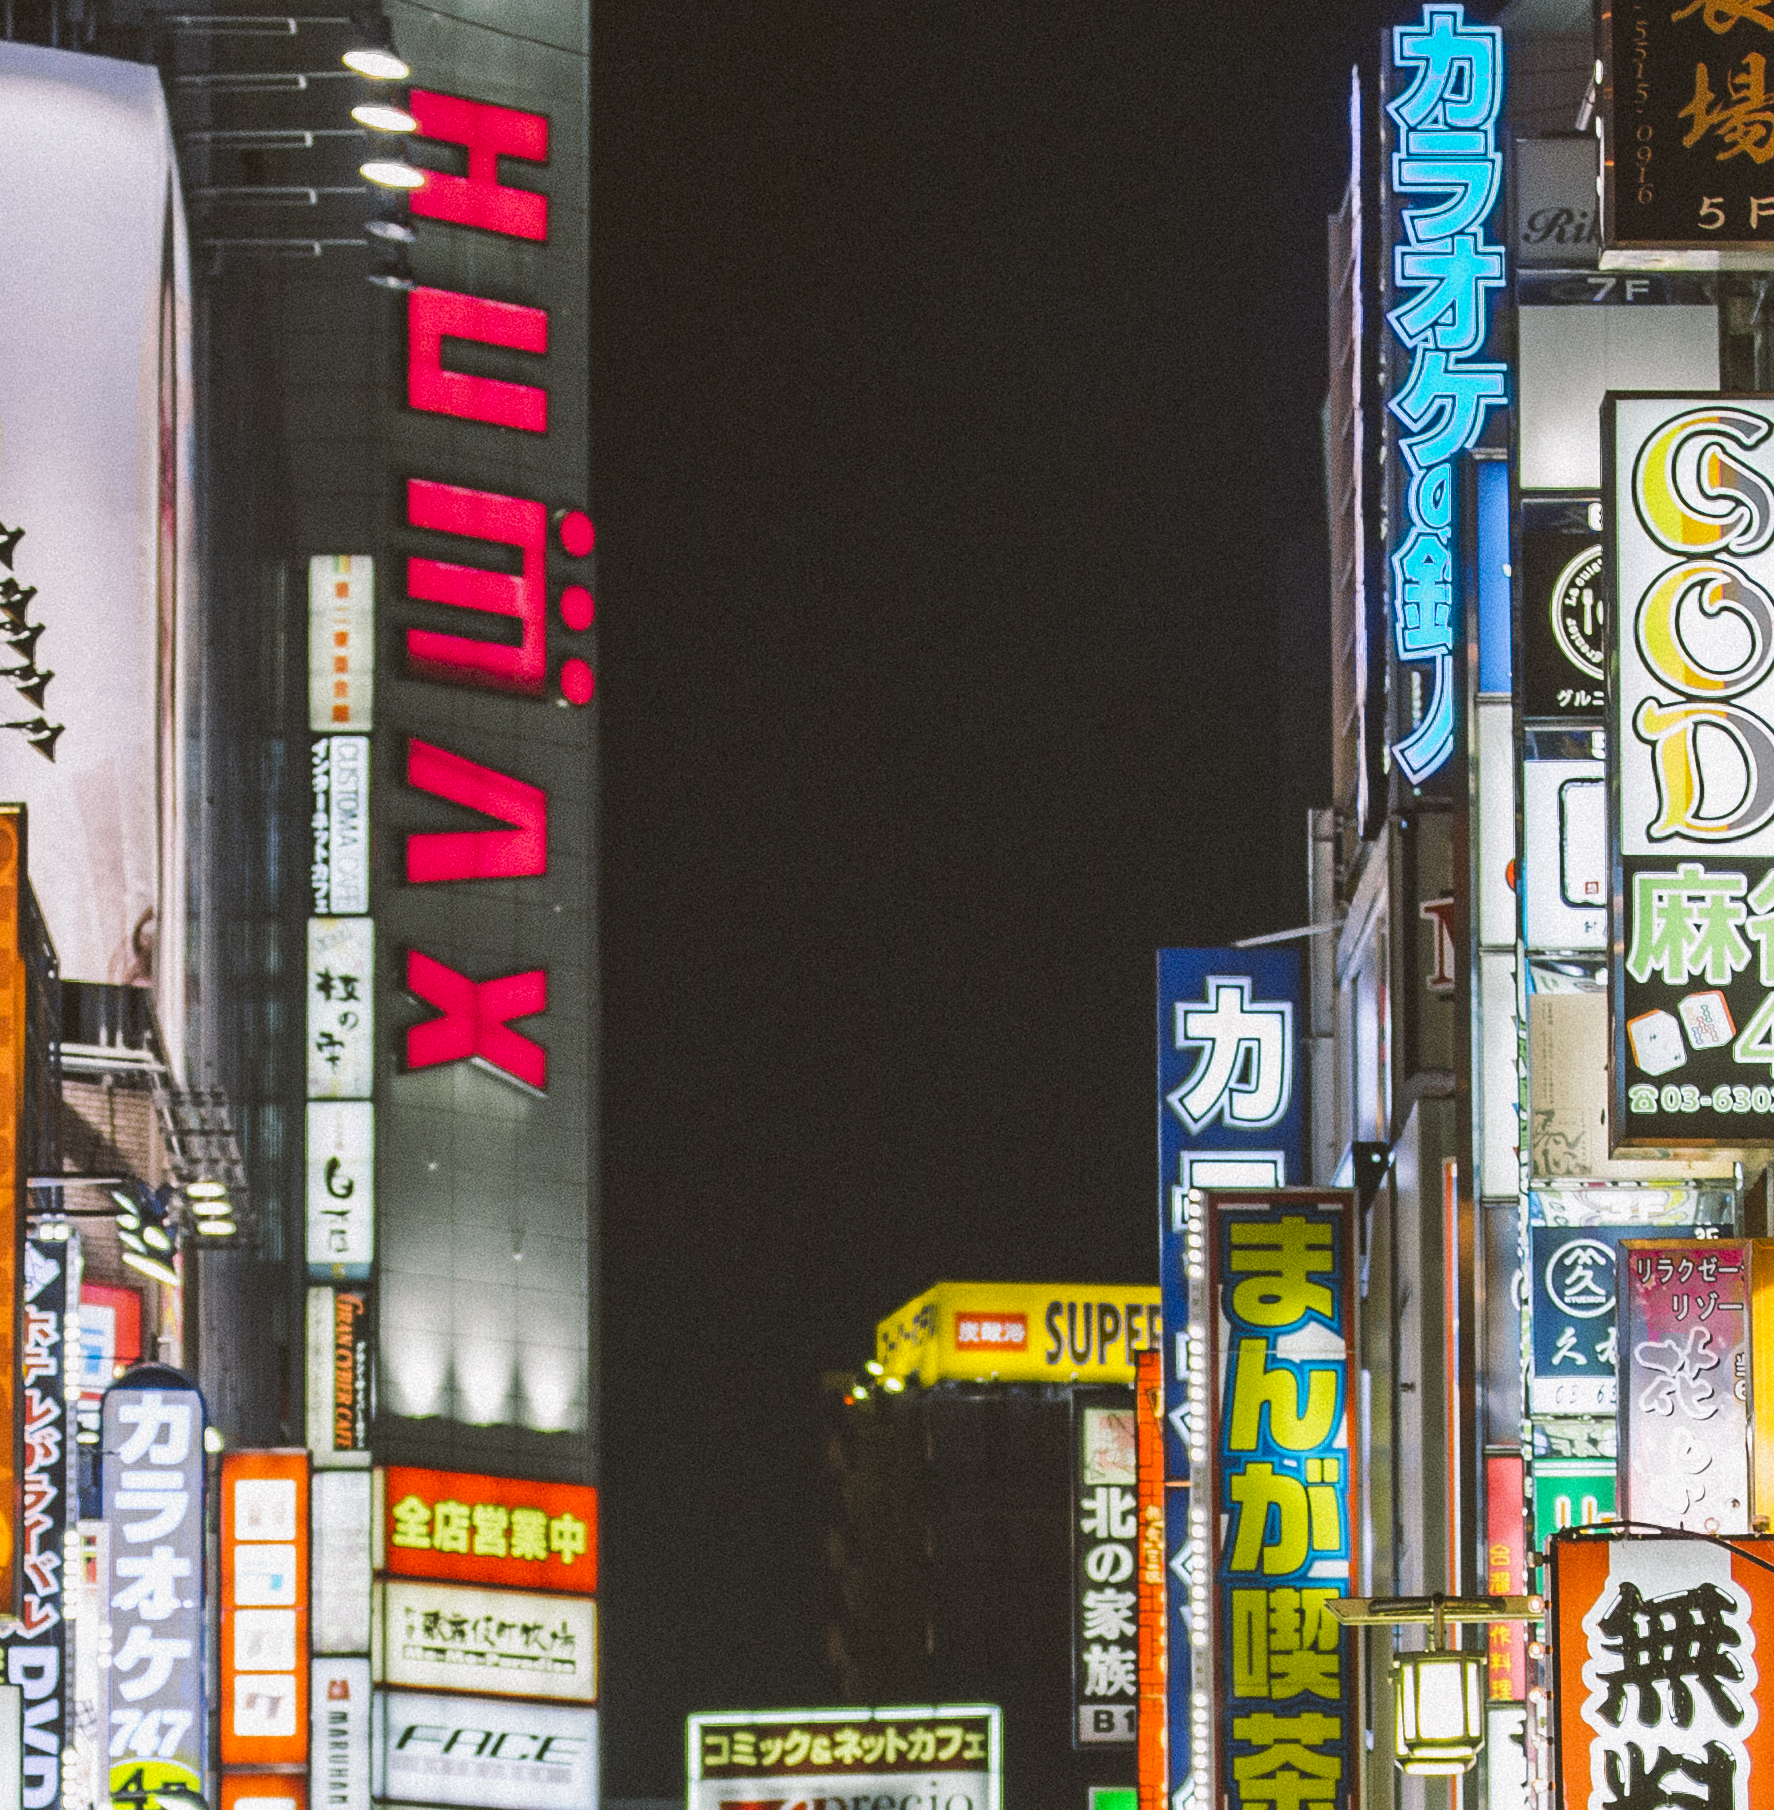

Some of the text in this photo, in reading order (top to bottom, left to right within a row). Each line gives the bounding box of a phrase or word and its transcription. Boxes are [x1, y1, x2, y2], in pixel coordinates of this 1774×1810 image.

[1587, 278, 1650, 301] 7F
[407, 88, 596, 1092] HUMAX
[111, 1392, 195, 1700] カラオケ
[392, 1495, 588, 1565] 全店営業中
[1081, 1486, 1137, 1696] 北の家族
[109, 1709, 195, 1759] 747
[394, 1724, 588, 1763] FACE
[703, 1725, 986, 1768] コミック&ネットカフェ
[1093, 1710, 1136, 1733] B1
[329, 1711, 348, 1803] MARUHAN
